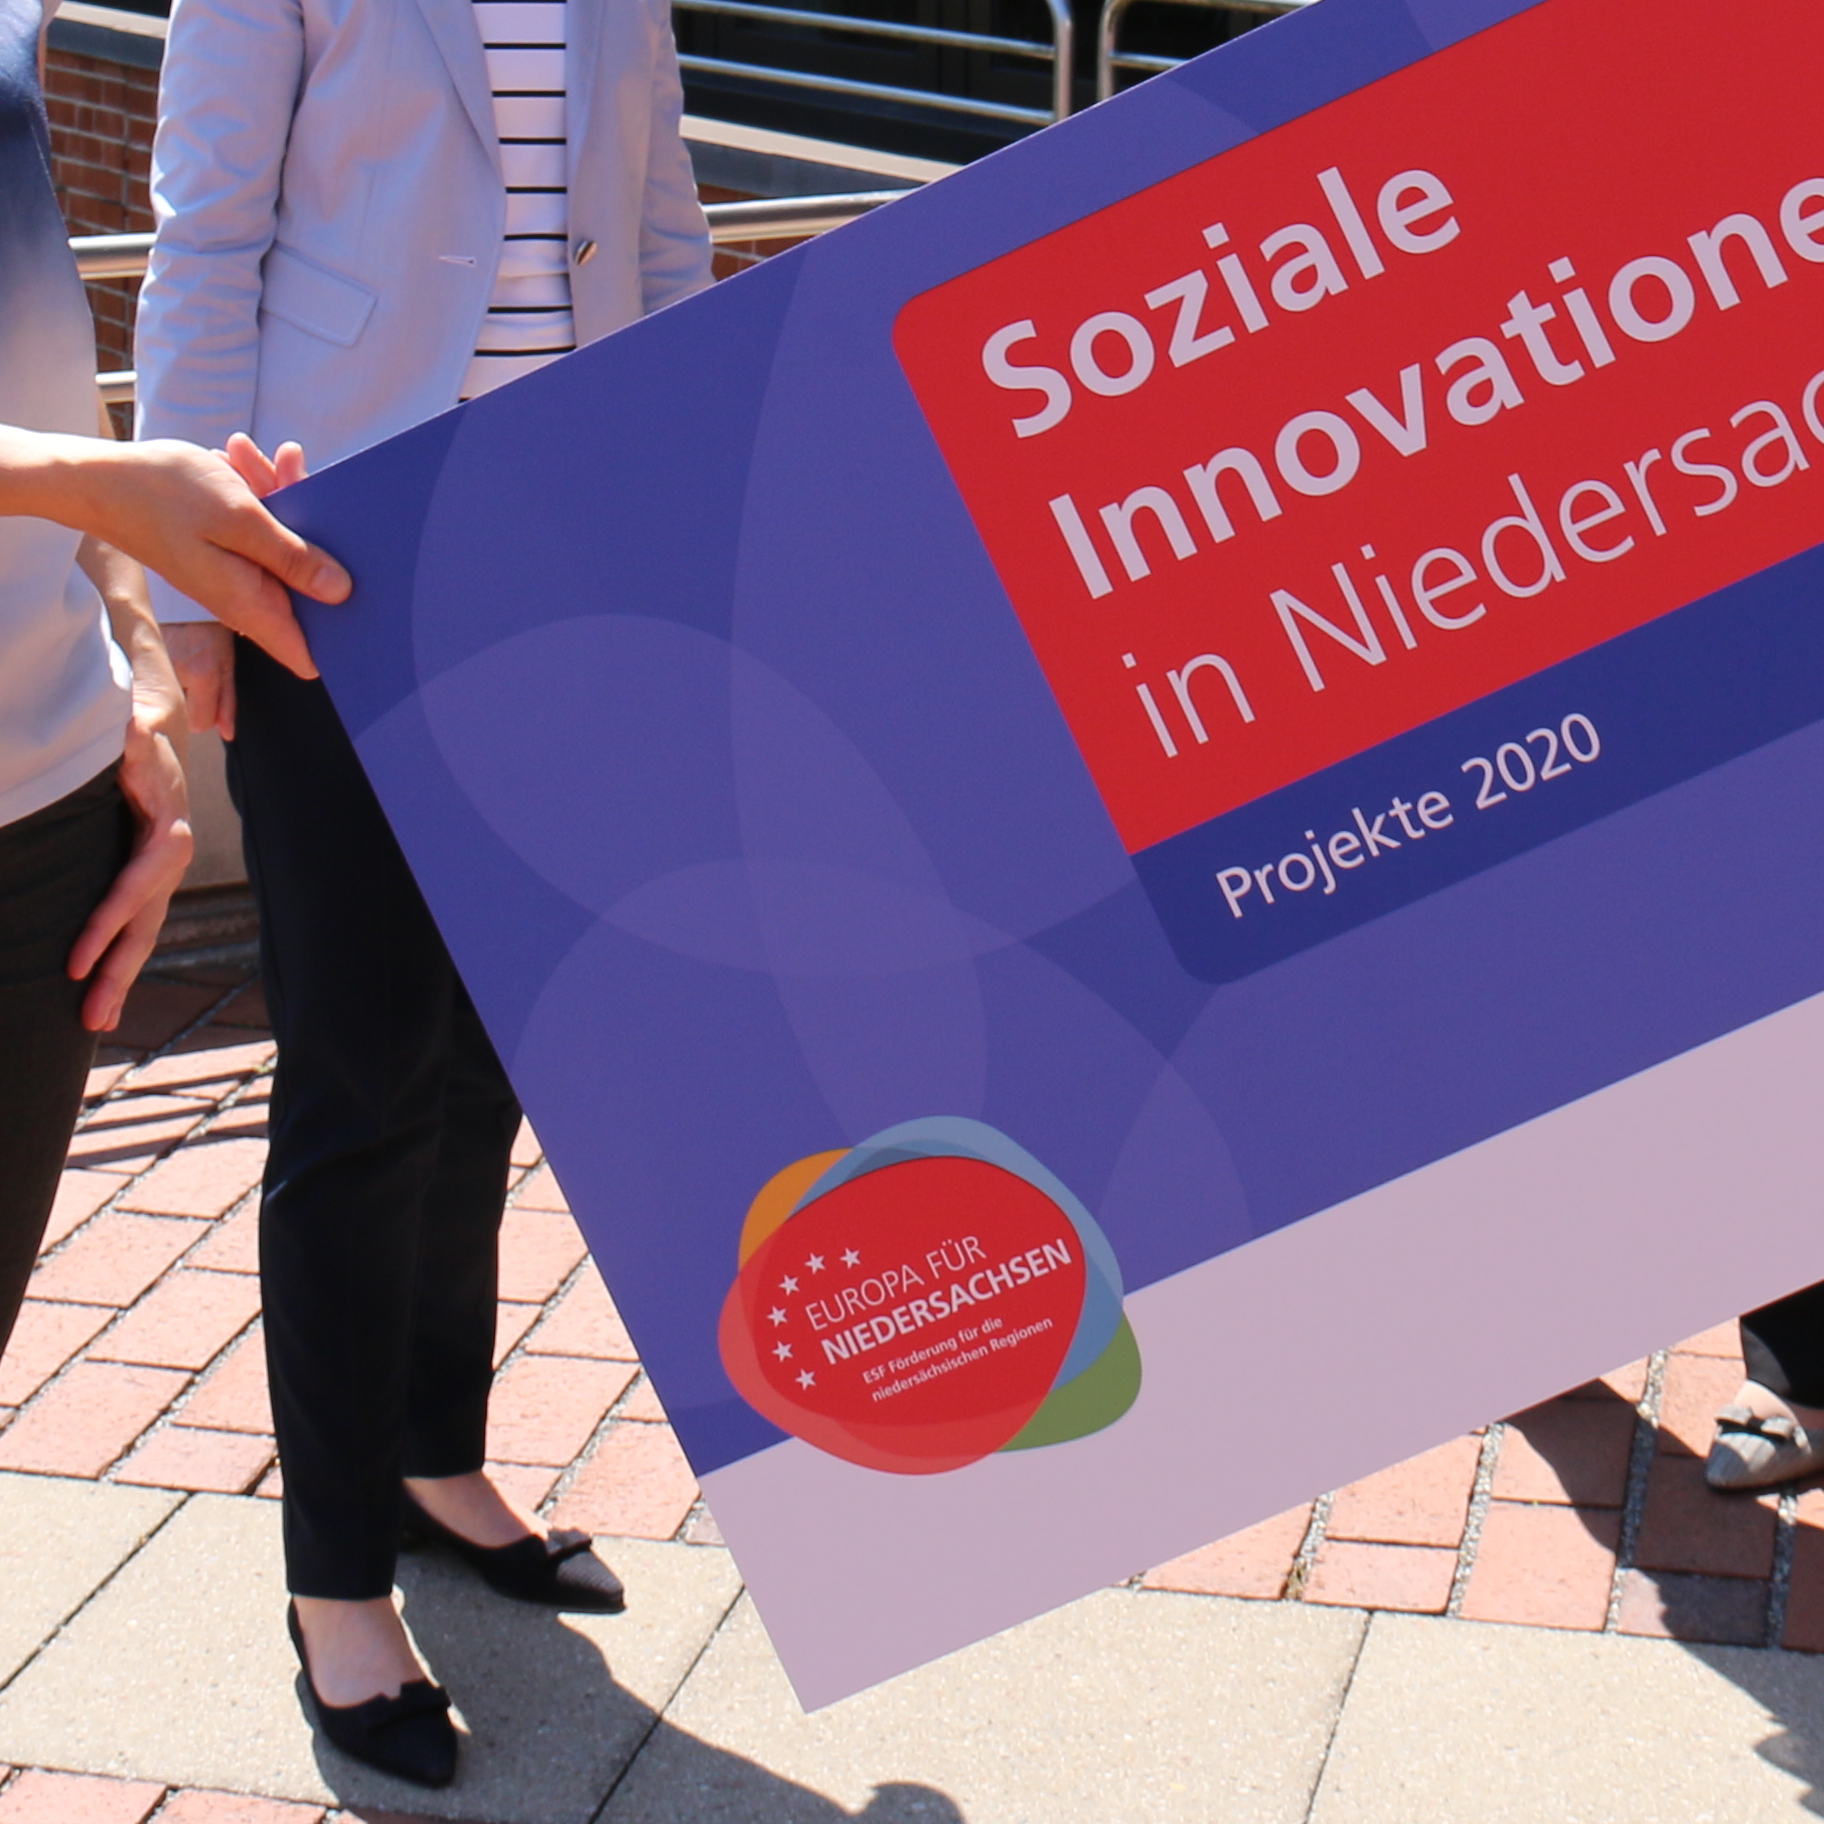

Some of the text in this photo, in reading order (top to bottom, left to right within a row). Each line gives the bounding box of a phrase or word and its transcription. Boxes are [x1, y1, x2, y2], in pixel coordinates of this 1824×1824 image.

[982, 169, 1461, 439] Soziale
[1121, 652, 1256, 758] in
[1216, 713, 1600, 918] Projekte 2020
[805, 1236, 986, 1331] EUROPA FÜR
[821, 1238, 1072, 1365] NIEDERSACHSEN
[862, 1318, 1003, 1384] ESF Förderung für die
[872, 1318, 1053, 1402] niedersächsischen Regionen
